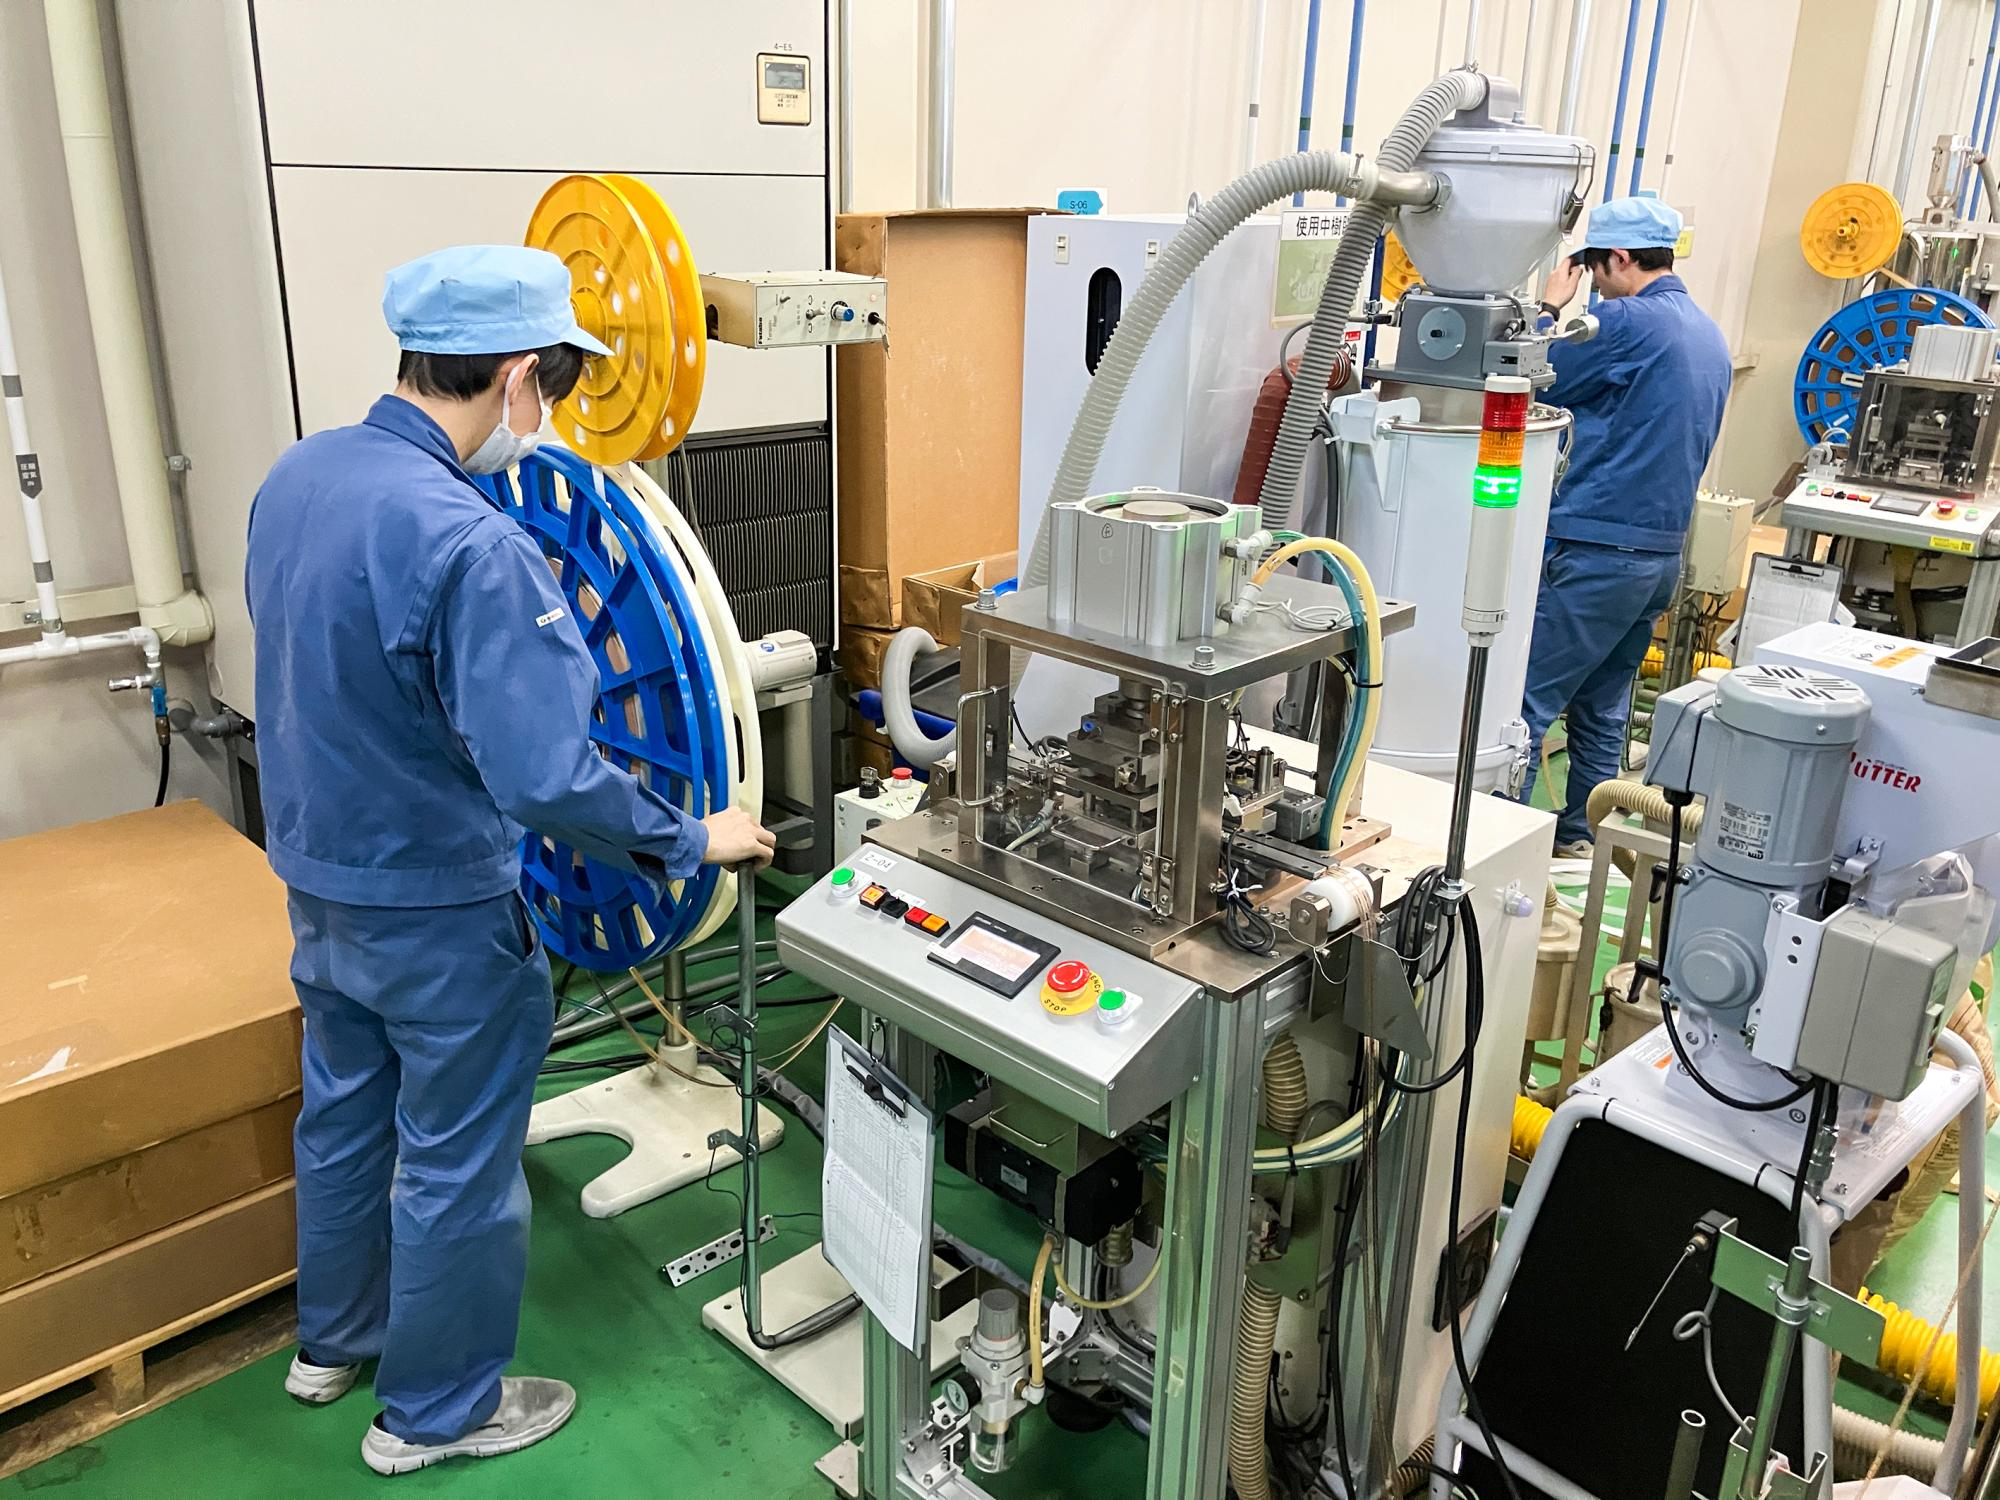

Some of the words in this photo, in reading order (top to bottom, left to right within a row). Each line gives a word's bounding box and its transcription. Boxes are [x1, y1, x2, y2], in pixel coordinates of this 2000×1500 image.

[1070, 200, 1088, 209] S-06
[1850, 752, 1921, 793] UTTER
[1044, 998, 1067, 1012] STOP
